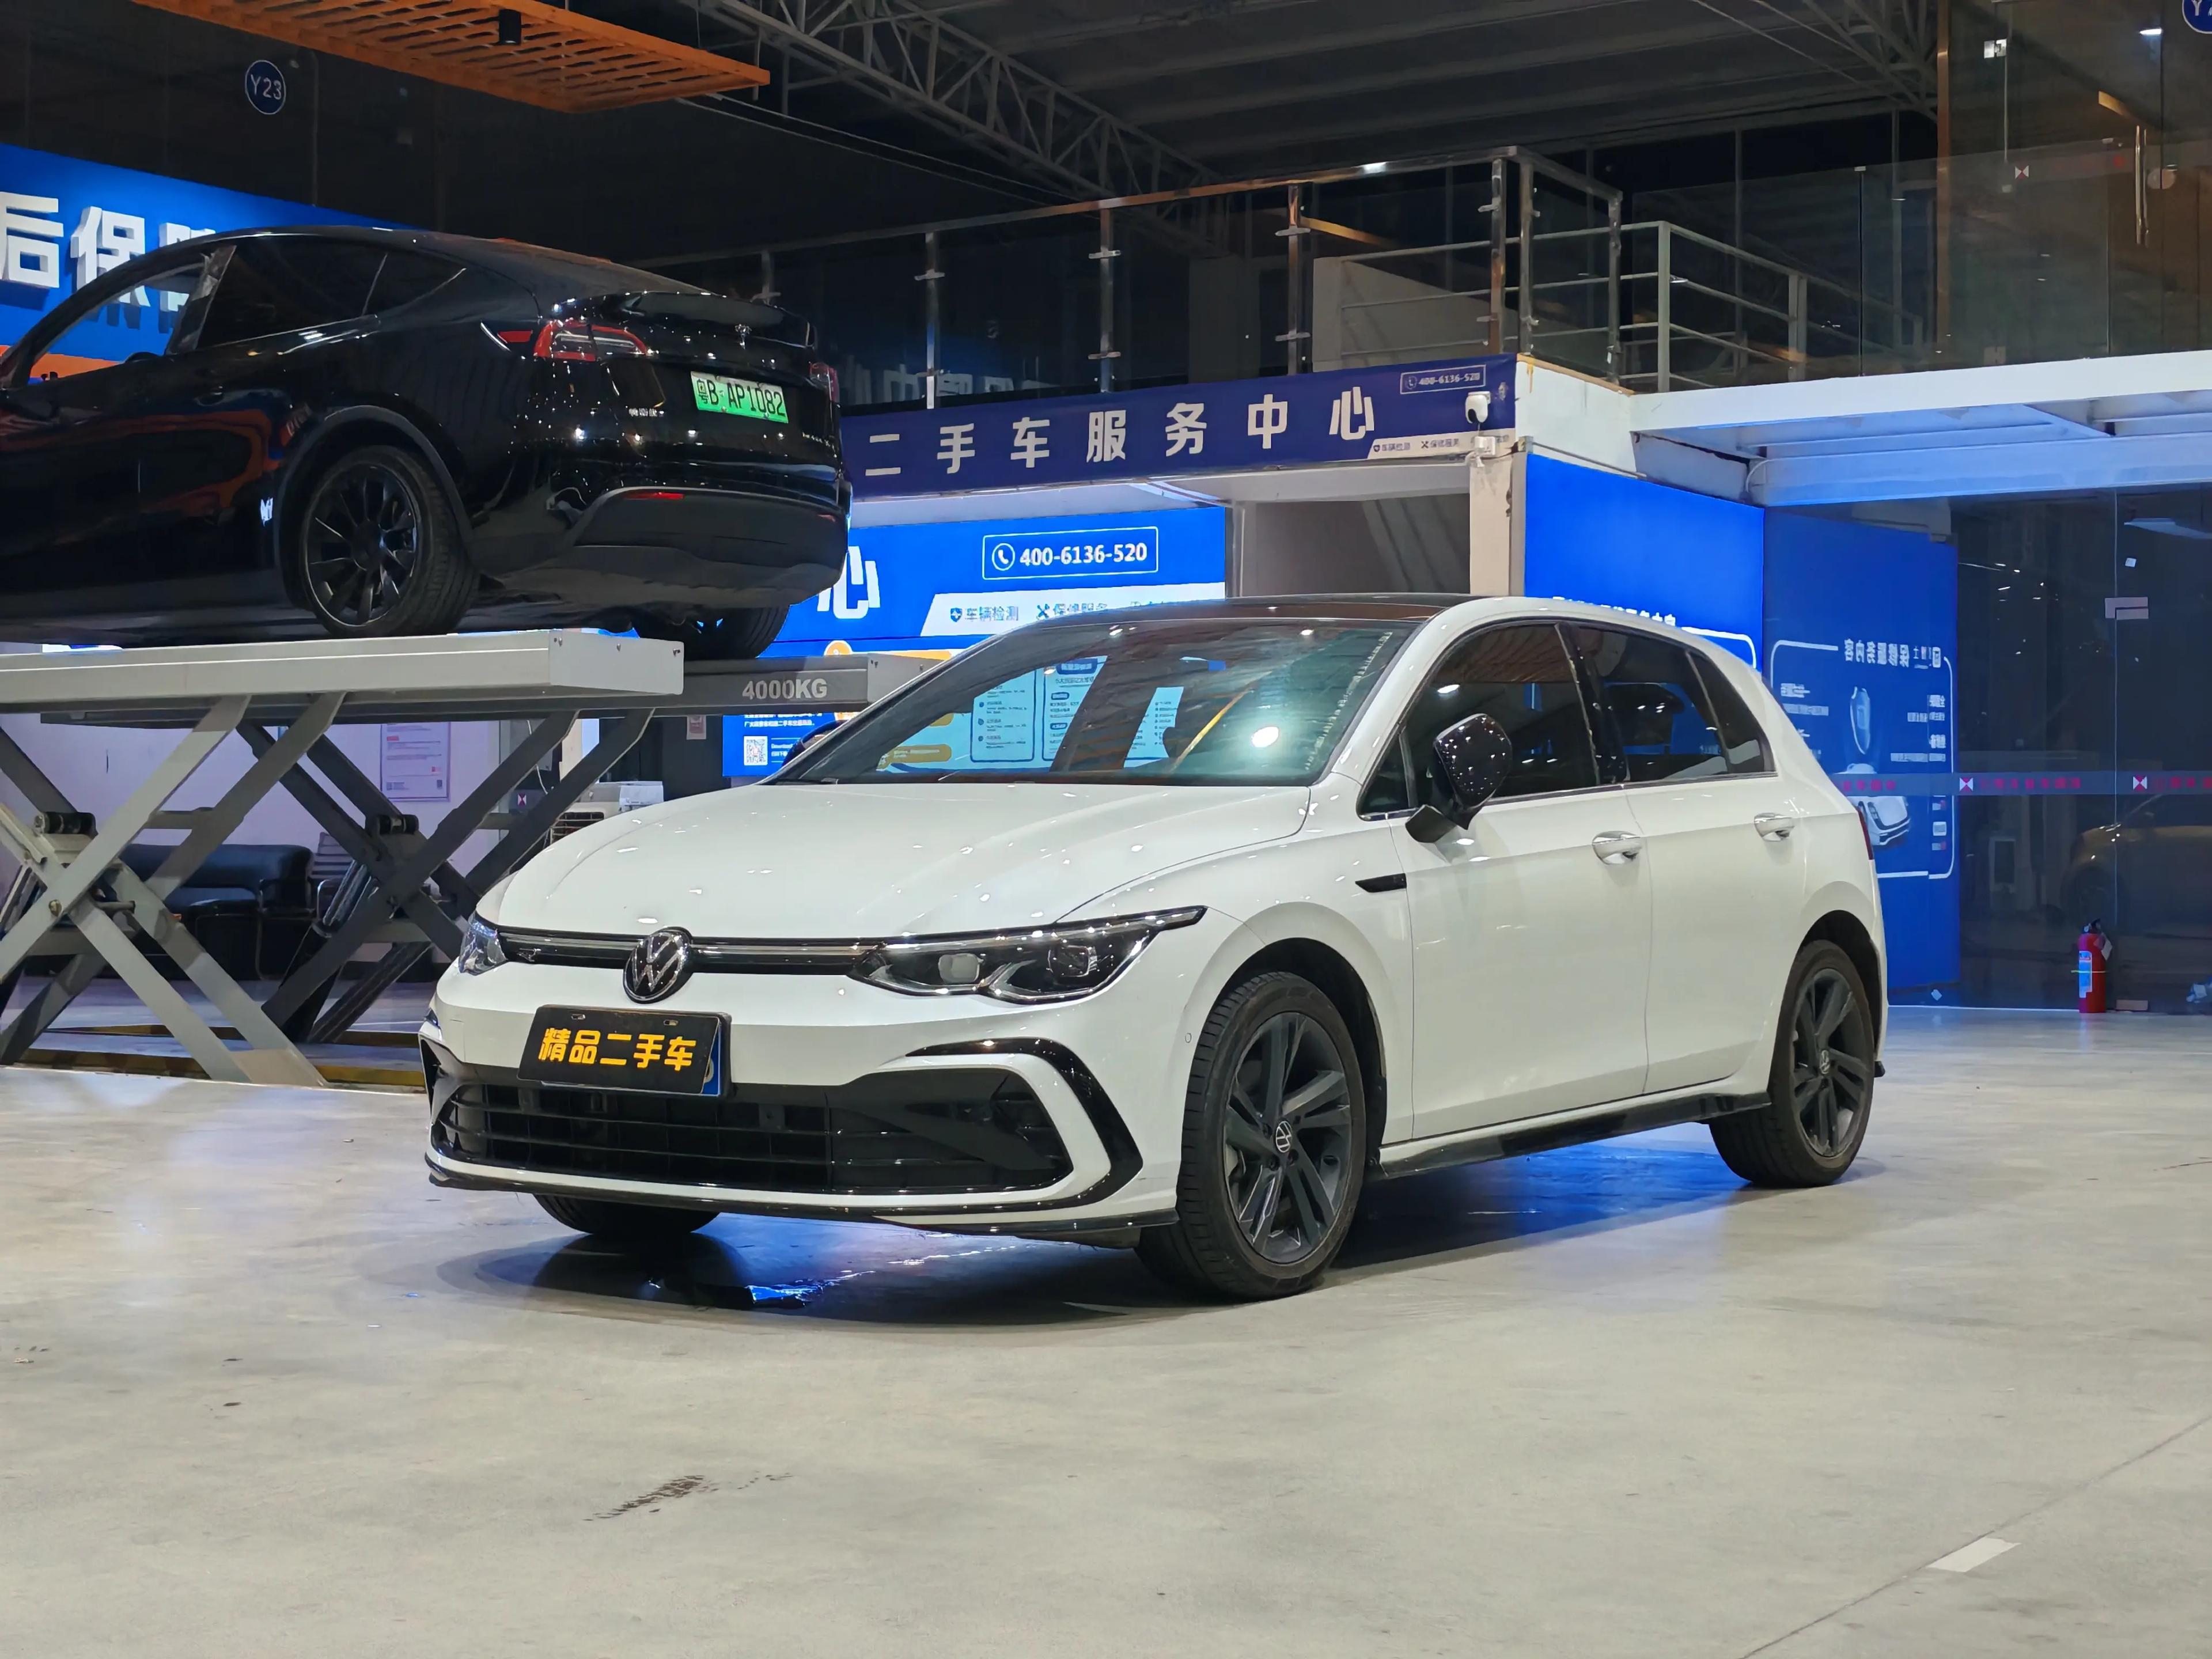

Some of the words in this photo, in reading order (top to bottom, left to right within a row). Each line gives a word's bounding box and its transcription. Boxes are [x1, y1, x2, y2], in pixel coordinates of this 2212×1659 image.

[251, 73, 282, 100] Y23
[865, 386, 1375, 476] 二手车服务中心
[1020, 543, 1147, 566] 400-6136-520
[742, 678, 828, 700] 4000KG
[537, 1027, 696, 1071] 精品二手车
